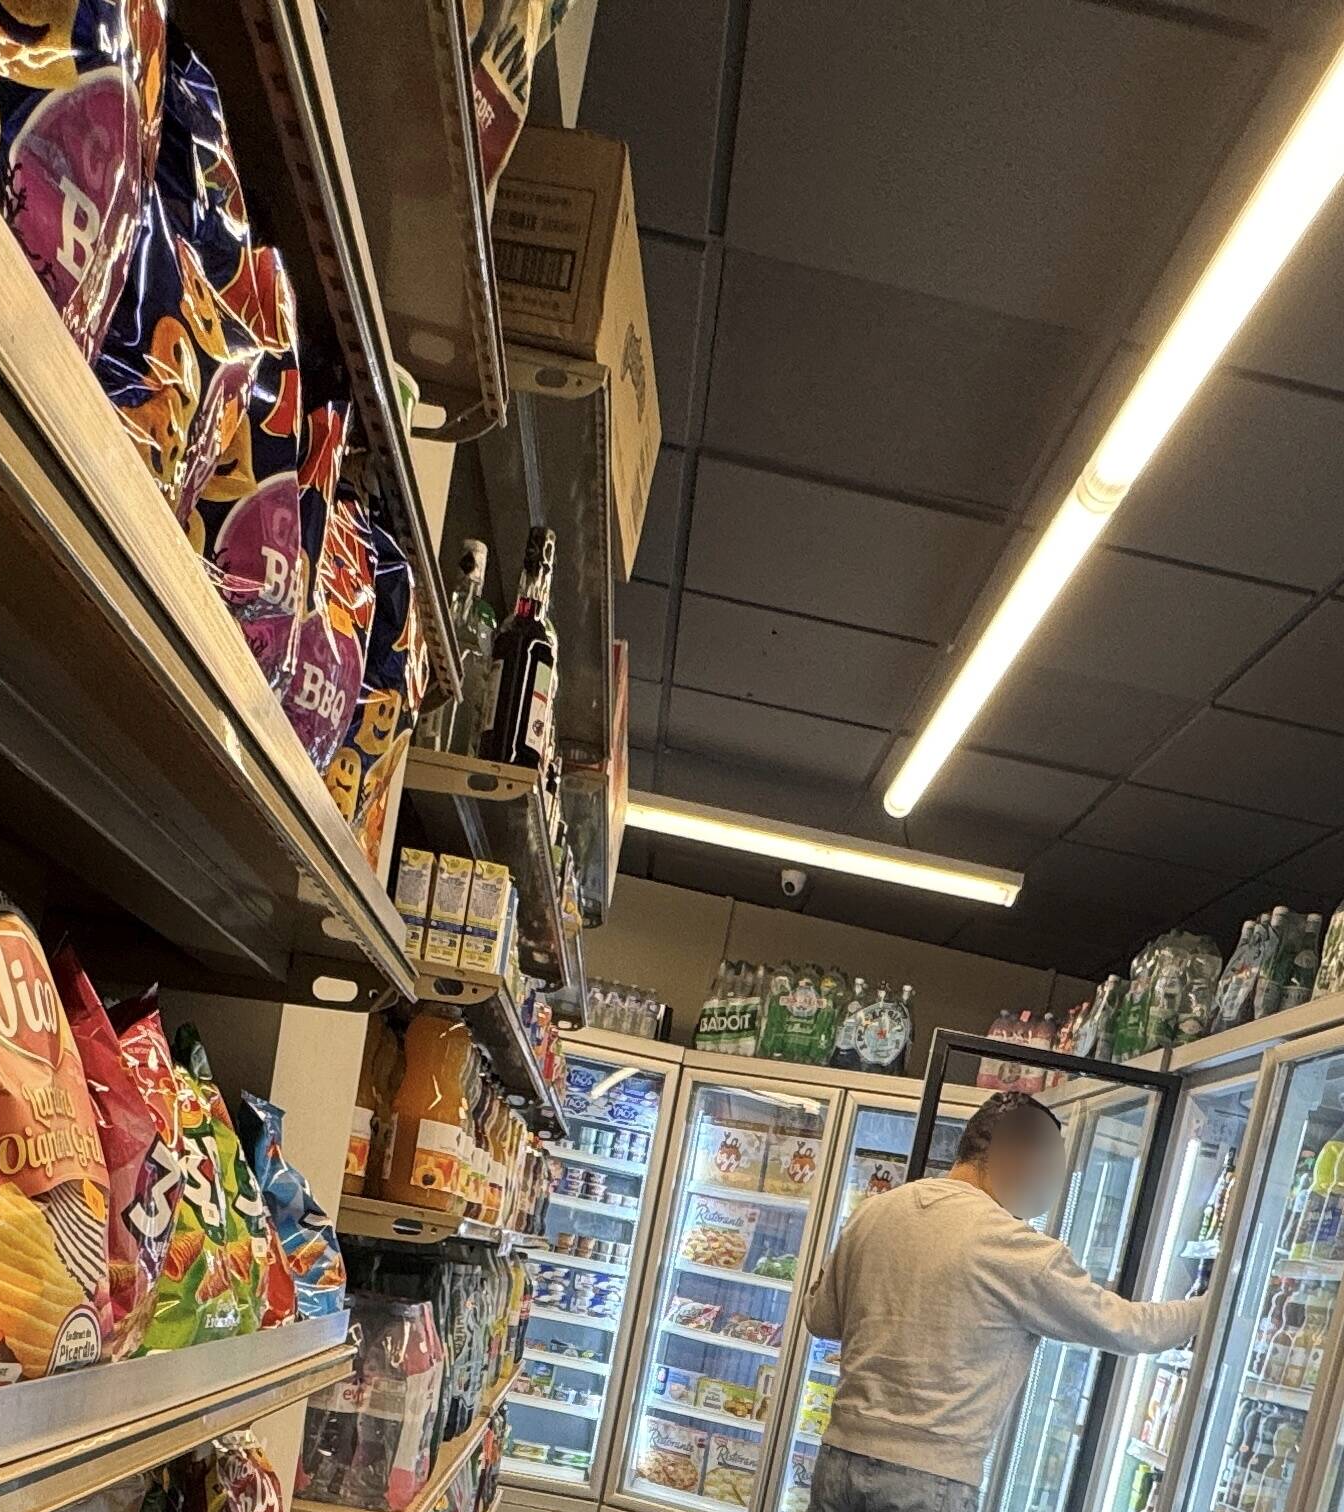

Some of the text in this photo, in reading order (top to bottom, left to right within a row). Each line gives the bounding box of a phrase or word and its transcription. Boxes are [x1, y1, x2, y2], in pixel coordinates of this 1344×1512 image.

[294, 660, 346, 732] BBQ
[700, 1014, 751, 1034] BADOIT
[696, 1204, 744, 1227] Ristorante
